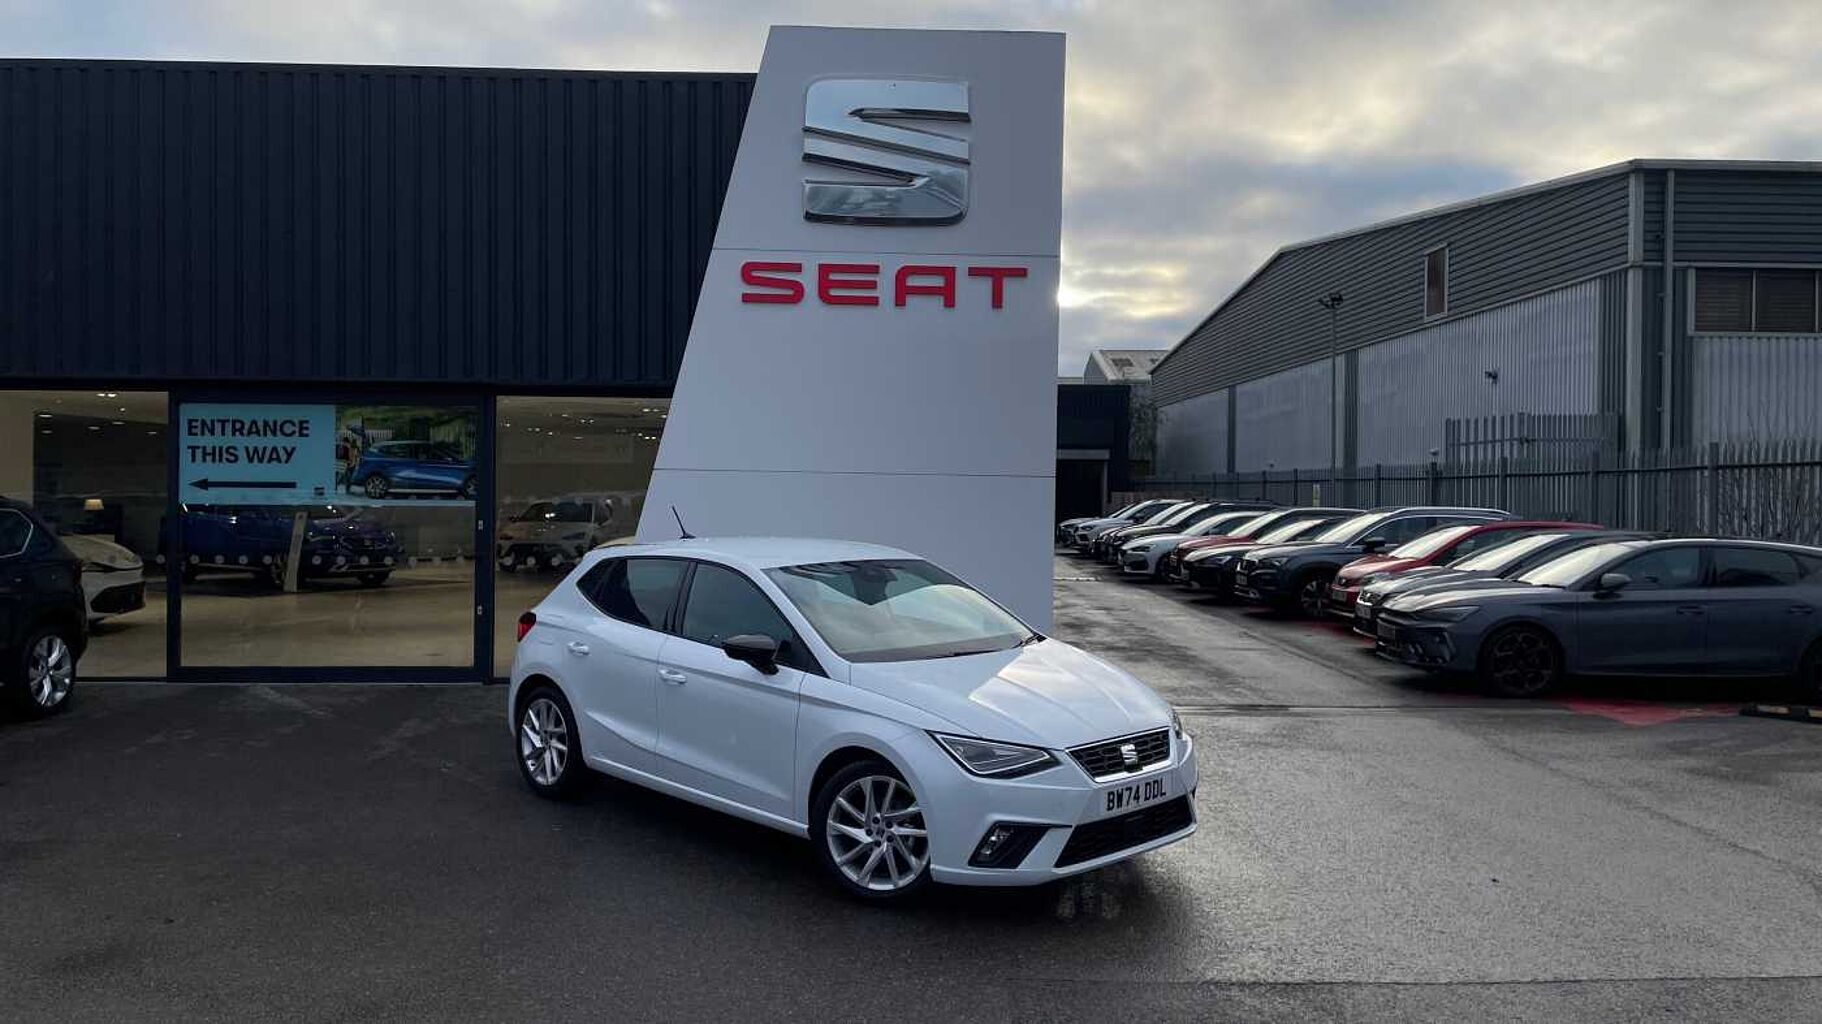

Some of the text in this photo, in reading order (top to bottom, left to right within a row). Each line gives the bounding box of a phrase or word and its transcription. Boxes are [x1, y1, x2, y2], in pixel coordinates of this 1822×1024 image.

[740, 261, 1028, 309] SEAT
[186, 418, 311, 438] ENTRANCE
[186, 445, 297, 464] THIS WAY
[1106, 778, 1167, 811] BW74 DDL
